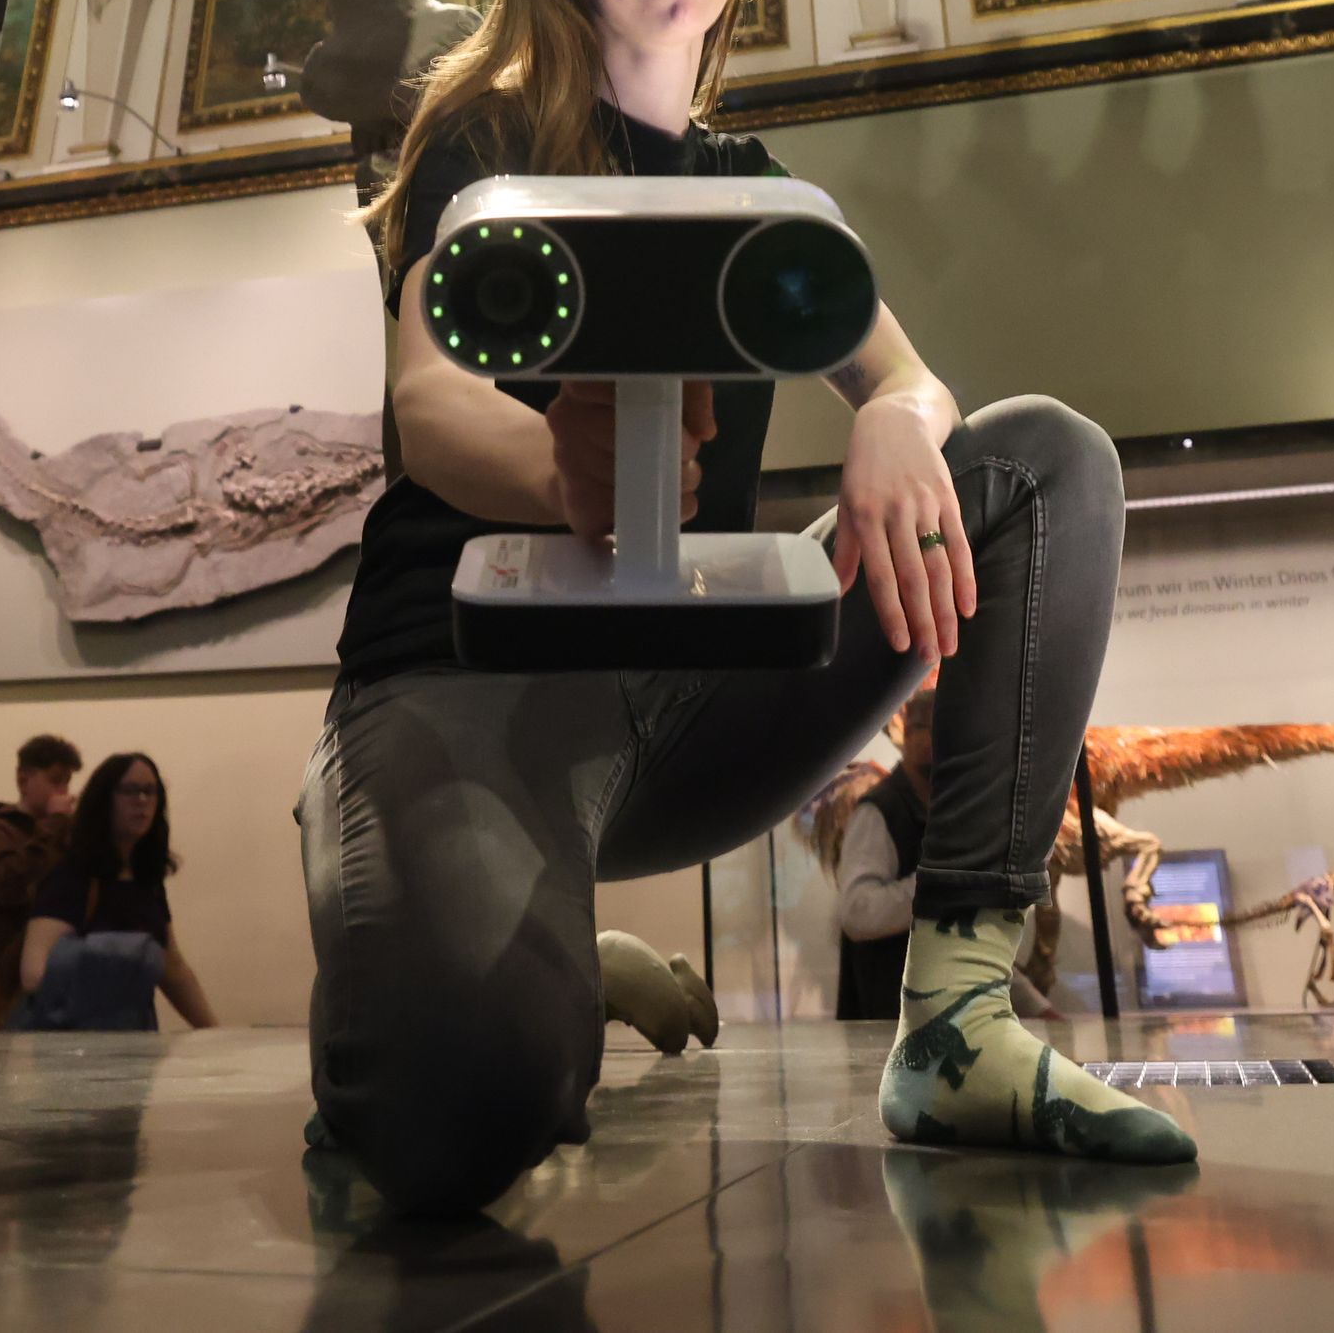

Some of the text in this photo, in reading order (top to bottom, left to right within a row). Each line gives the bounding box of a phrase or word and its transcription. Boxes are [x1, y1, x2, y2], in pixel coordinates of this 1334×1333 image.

[1117, 583, 1152, 598] rum
[1157, 579, 1182, 594] wir
[1188, 577, 1211, 593] im
[1213, 572, 1273, 591] Winter
[1277, 569, 1328, 587] Dinos
